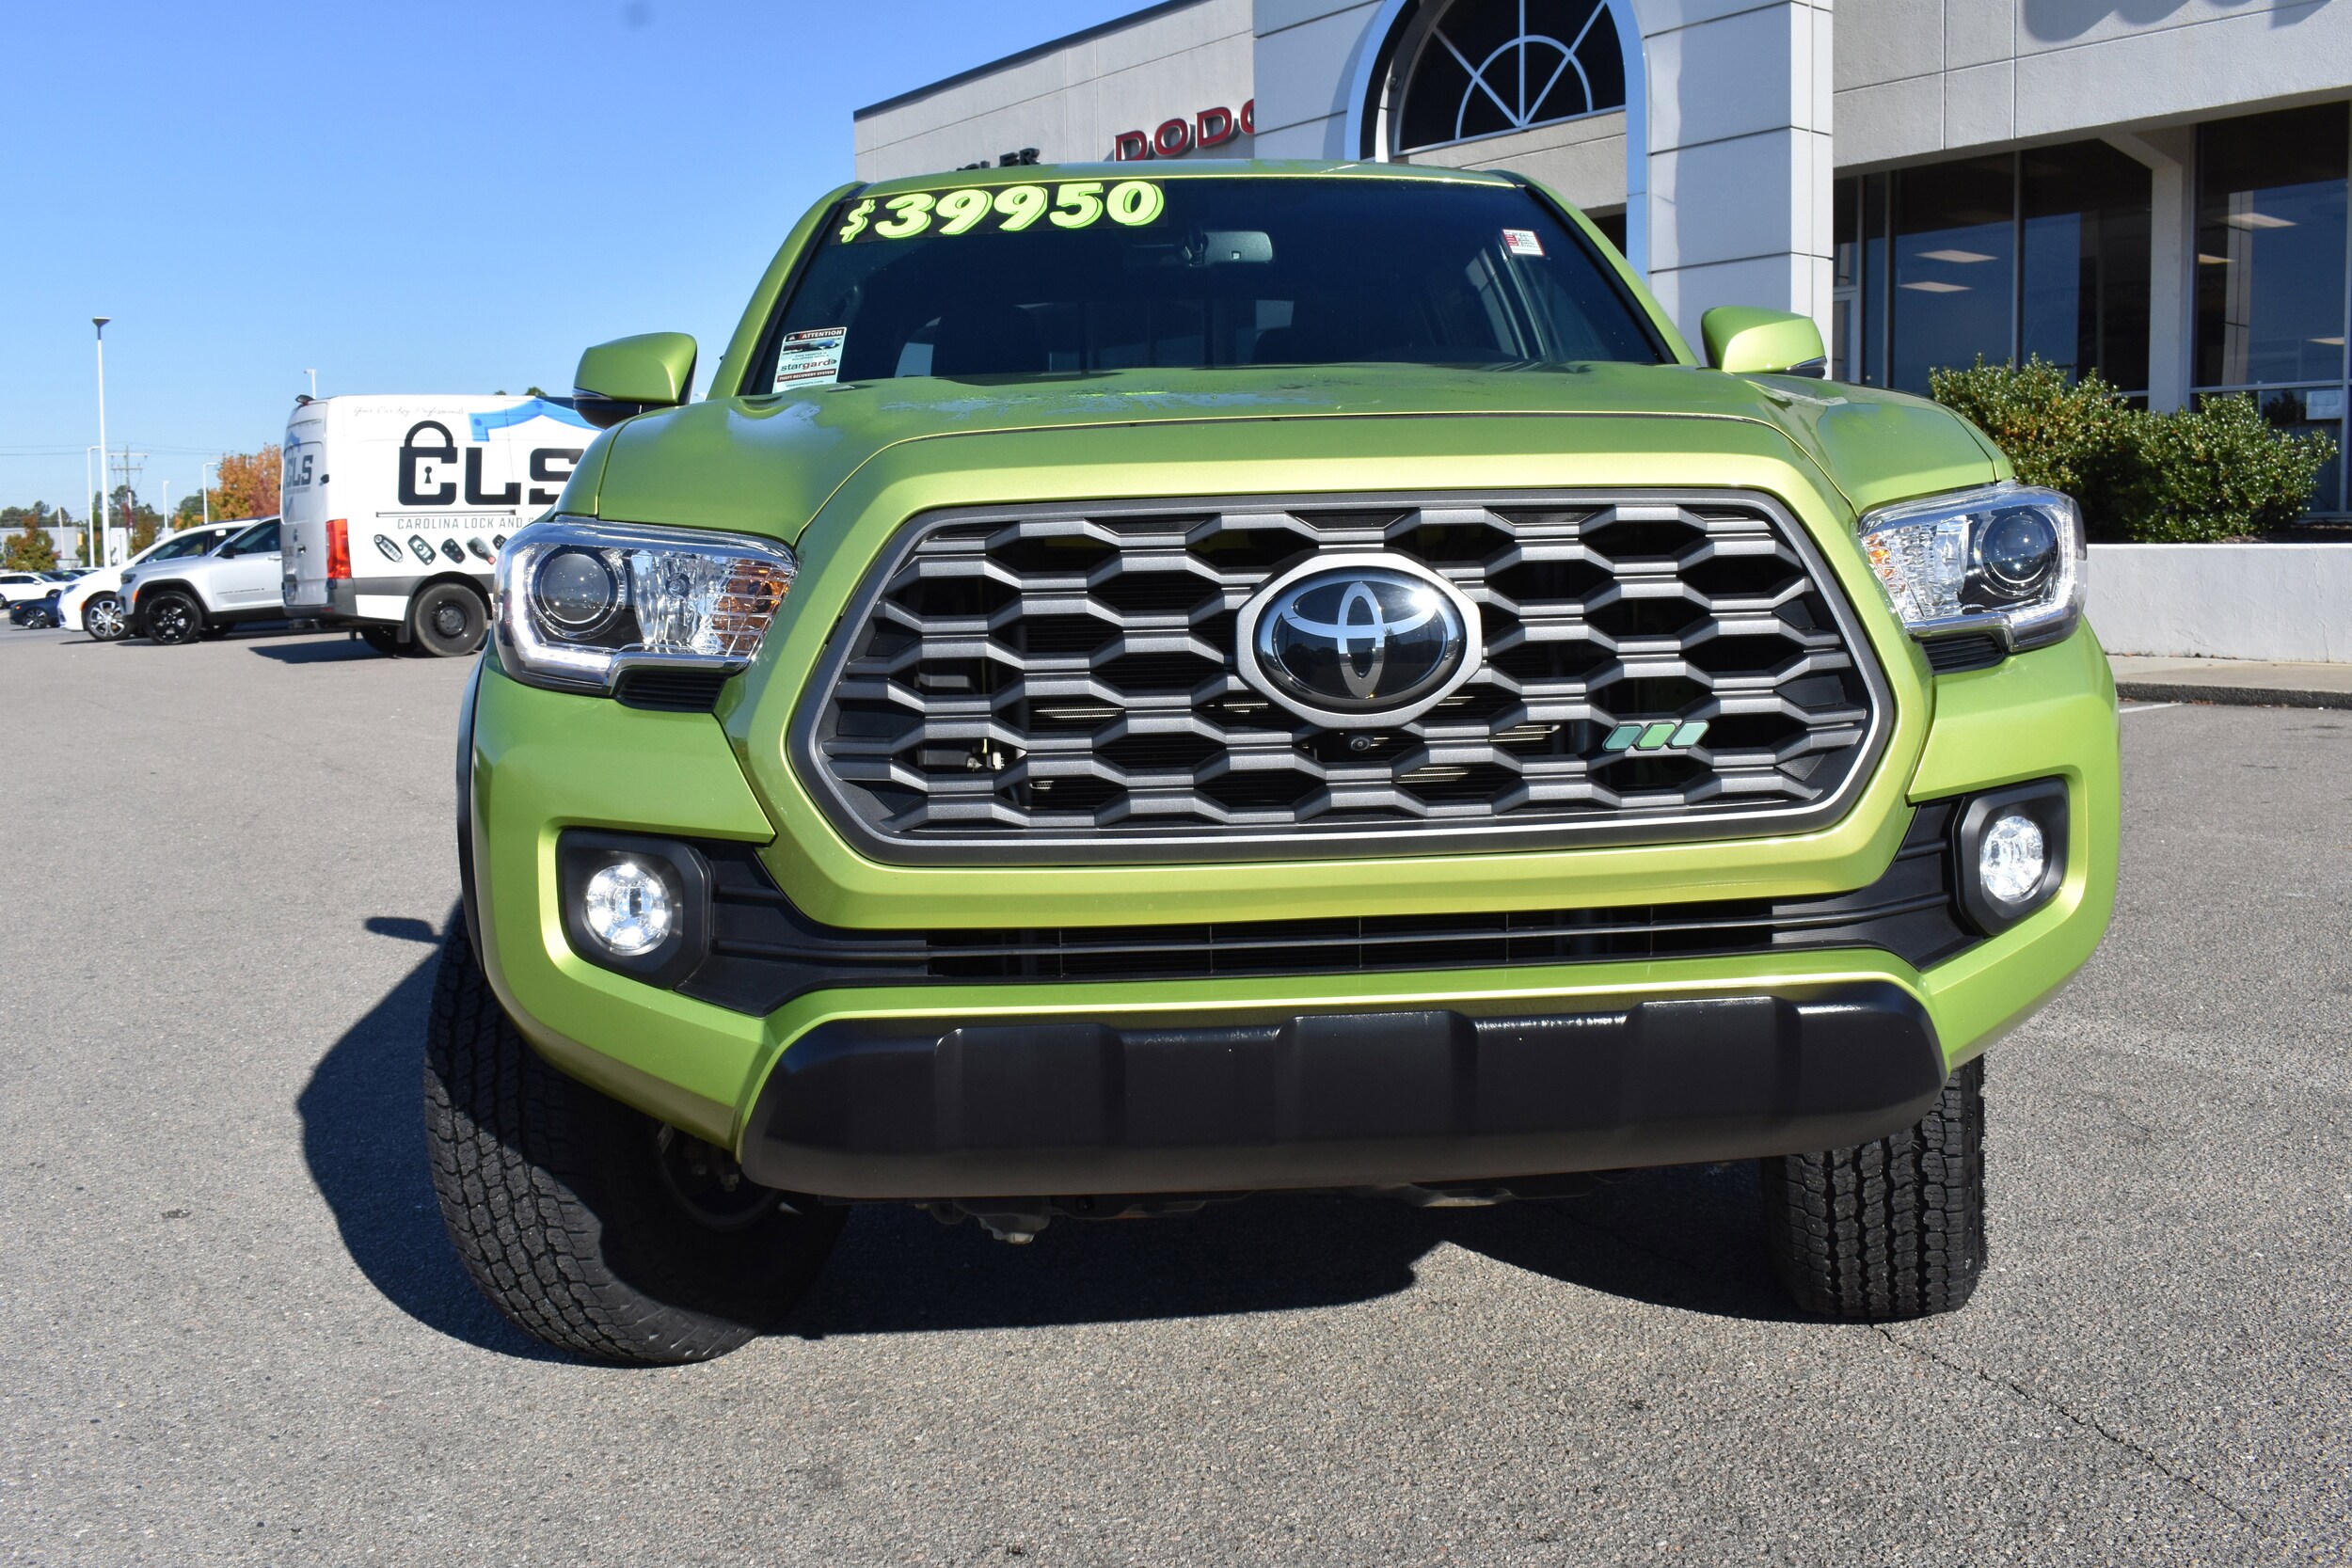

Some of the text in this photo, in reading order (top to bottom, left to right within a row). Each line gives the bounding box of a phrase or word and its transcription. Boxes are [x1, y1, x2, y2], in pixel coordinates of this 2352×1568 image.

[802, 329, 843, 339] ATTENTION
[398, 446, 584, 505] CLS
[397, 517, 459, 530] CAROLINA
[464, 516, 494, 529] LOCK
[499, 516, 523, 529] AND
